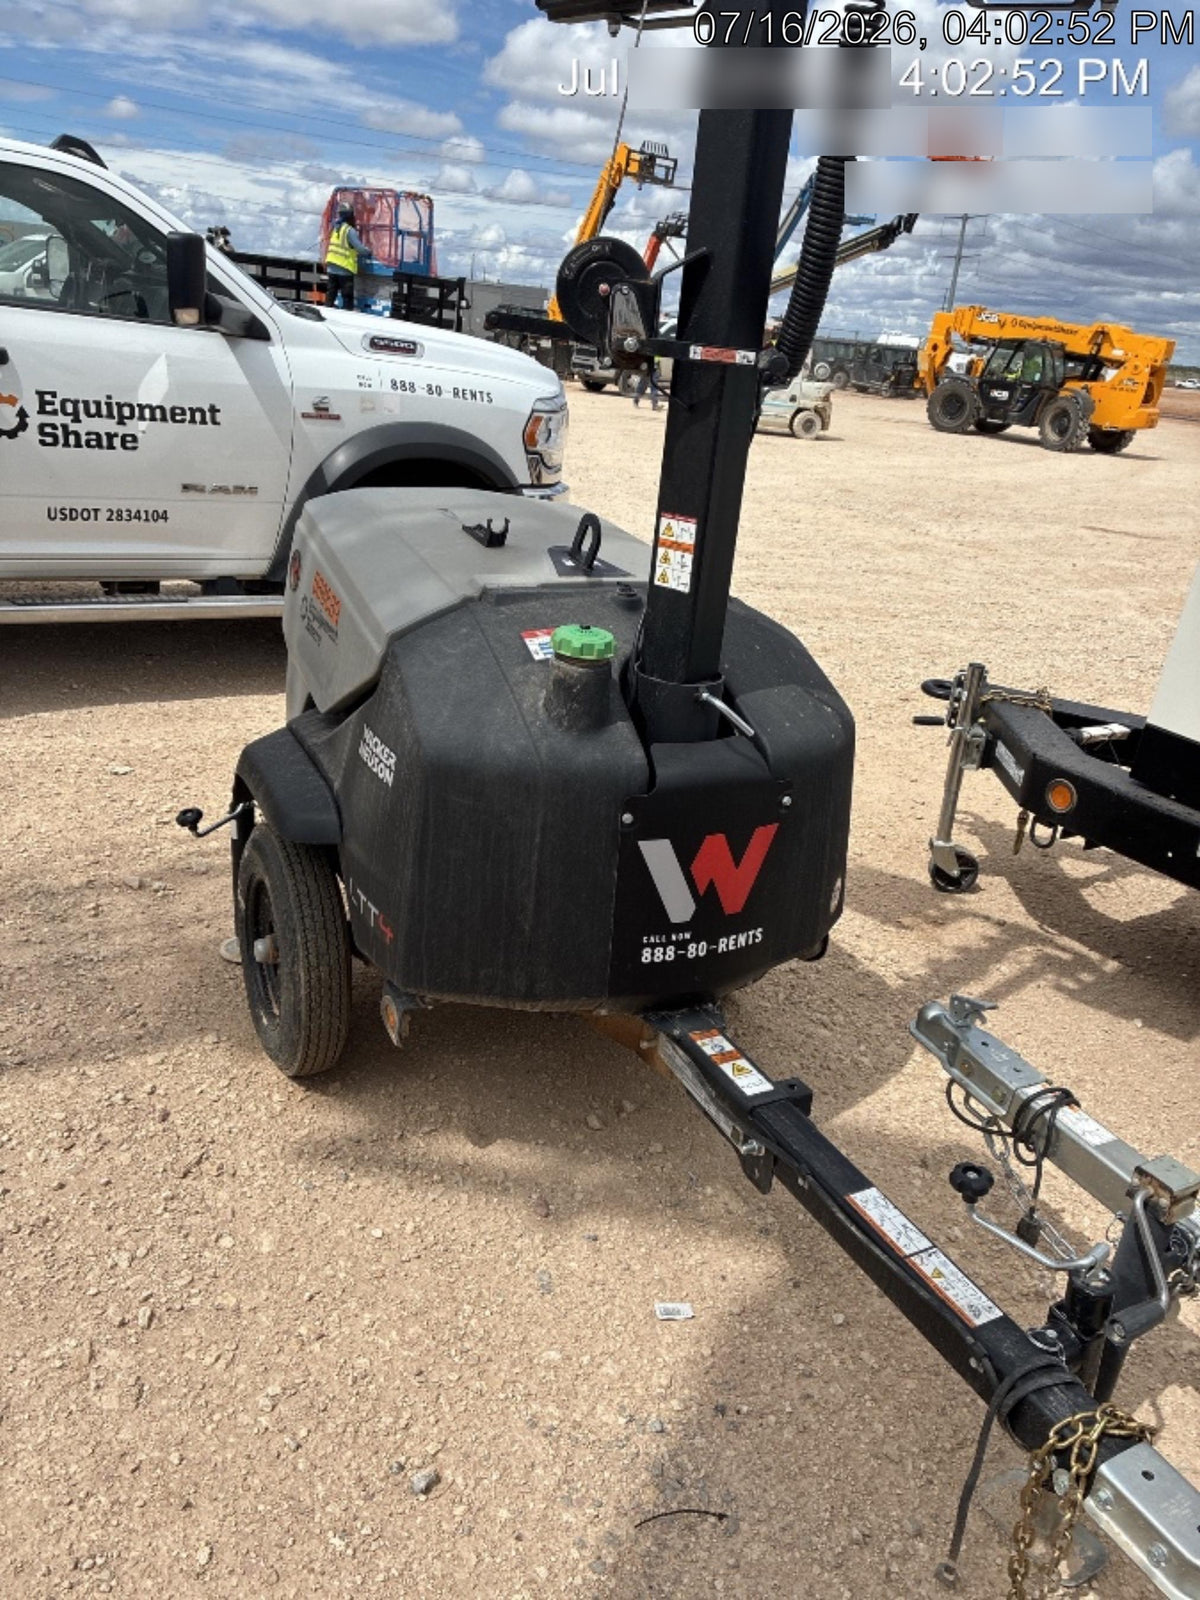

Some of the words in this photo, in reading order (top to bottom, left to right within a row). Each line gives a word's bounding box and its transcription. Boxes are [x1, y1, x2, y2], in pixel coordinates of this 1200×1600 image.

[390, 378, 494, 404] 888-80-RENTS
[35, 389, 221, 426] Equipment
[37, 422, 140, 451] Share
[47, 507, 101, 522] USDOT
[106, 508, 169, 523] 2834104
[358, 739, 394, 787] NEUSON
[641, 928, 763, 963] 888-80-RENTS
[643, 934, 666, 943] CALL
[671, 931, 692, 942] NOW
